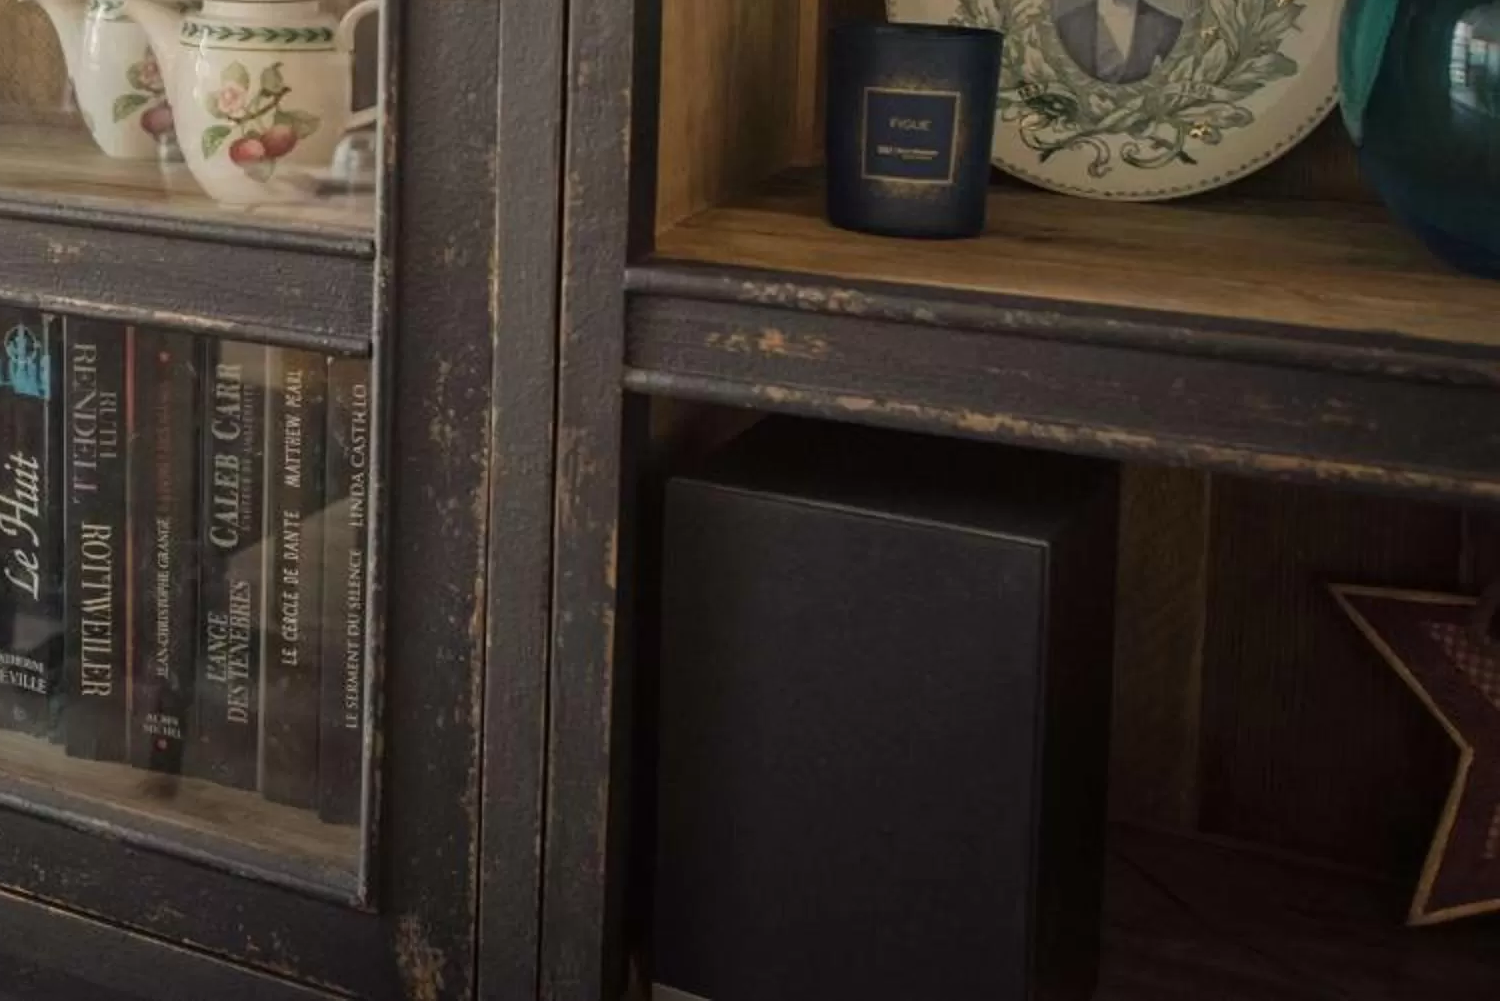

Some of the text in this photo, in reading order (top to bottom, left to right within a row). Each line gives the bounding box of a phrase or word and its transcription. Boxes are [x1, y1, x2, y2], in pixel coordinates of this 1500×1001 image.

[72, 343, 98, 505] RENDELL
[99, 391, 117, 459] RUTH
[209, 364, 243, 548] CALEB CARR
[283, 370, 304, 488] MATTHEW PEARL
[348, 384, 368, 528] LINDA CASTILLO
[3, 548, 40, 602] Le
[81, 521, 113, 697] ROTTWEILER
[206, 610, 229, 683] L'ANGE
[281, 510, 301, 667] LE CERCLE DE DANTE
[345, 550, 363, 729] LE SERMENT DU SILENCE
[227, 685, 249, 724] DES
